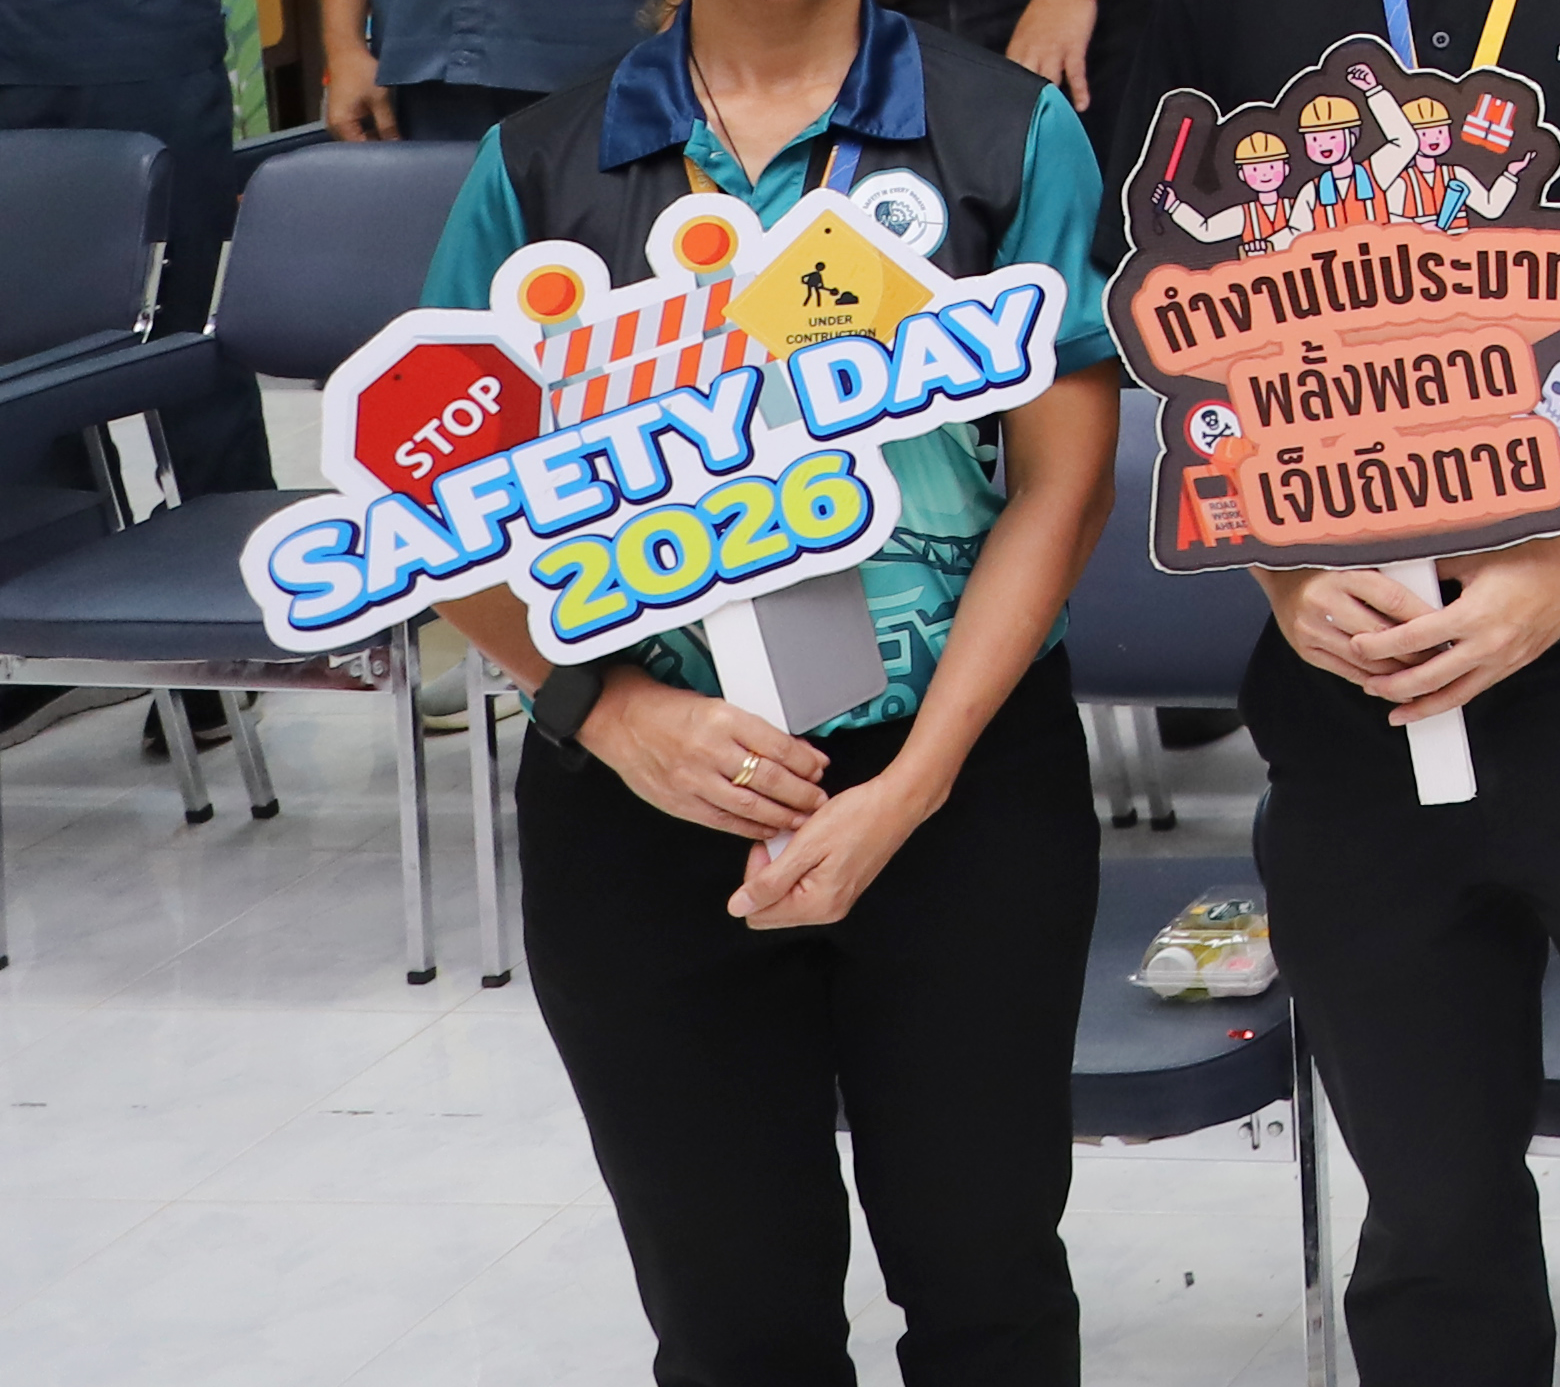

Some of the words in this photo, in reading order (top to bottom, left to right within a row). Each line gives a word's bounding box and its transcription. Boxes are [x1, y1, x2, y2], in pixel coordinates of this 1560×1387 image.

[808, 315, 853, 327] UNDER
[393, 372, 504, 481] STOP
[1249, 340, 1518, 428] พลั้งพลาด
[271, 367, 760, 629] SAFETY
[790, 284, 1044, 438] DAY
[1259, 435, 1546, 529] เจ็บถึงตาย
[533, 451, 872, 641] 2026
[1208, 500, 1237, 511] ROAD
